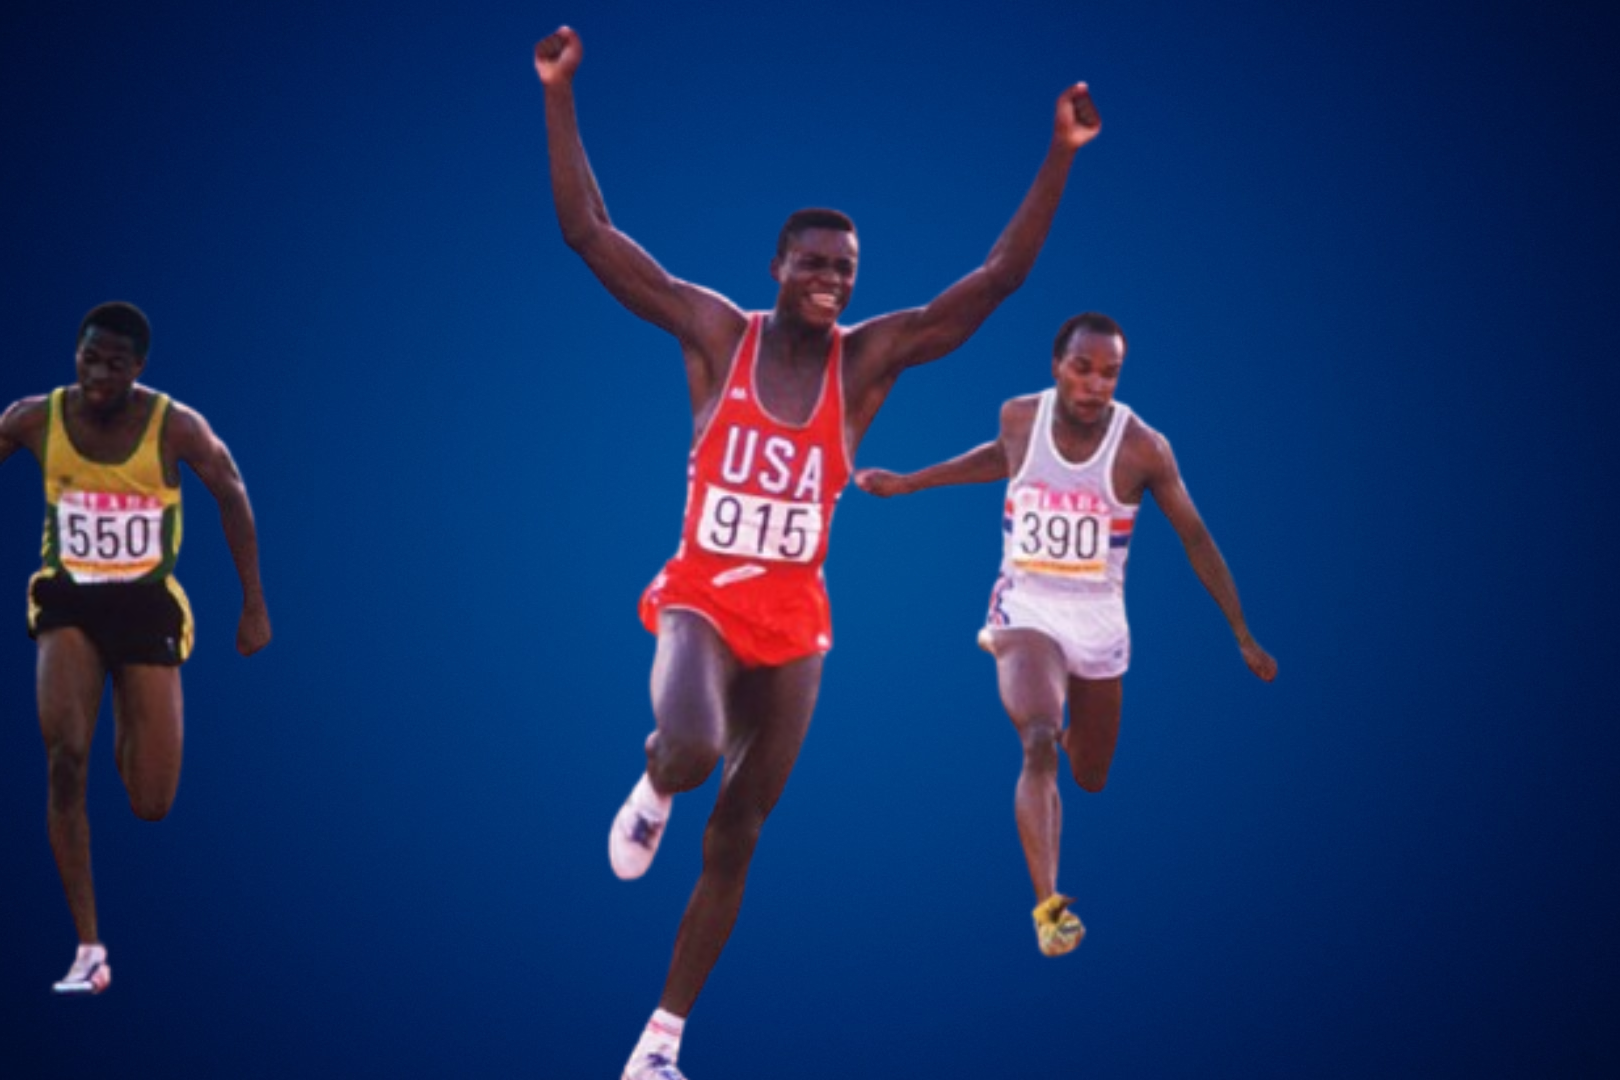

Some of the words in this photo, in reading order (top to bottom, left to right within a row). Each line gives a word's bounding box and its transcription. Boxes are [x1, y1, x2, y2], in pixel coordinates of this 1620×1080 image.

[721, 425, 823, 504] USA
[68, 513, 149, 559] 550
[710, 495, 808, 558] 915
[1020, 511, 1099, 559] 390
